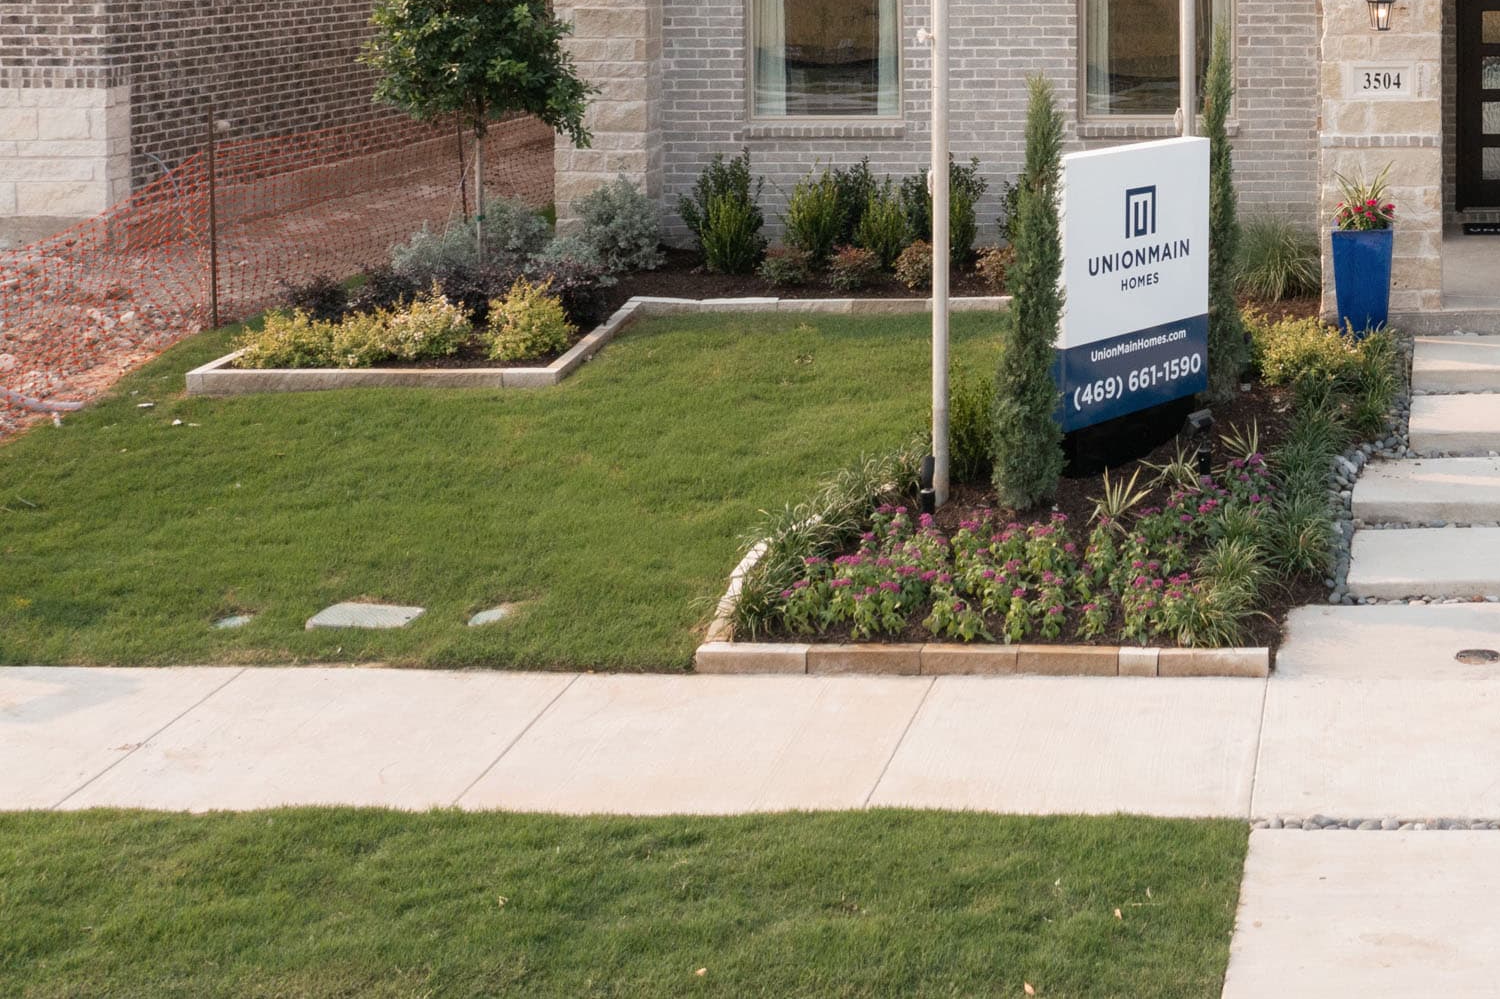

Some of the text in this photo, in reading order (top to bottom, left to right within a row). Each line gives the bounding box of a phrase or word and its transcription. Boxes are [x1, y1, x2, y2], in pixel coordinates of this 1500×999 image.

[1363, 72, 1401, 89] 3504
[1088, 238, 1191, 276] UNIONMAIN
[1120, 272, 1160, 292] HOMES
[1091, 329, 1186, 362] UnionMainHomes.com
[1074, 353, 1201, 411] (469) 661-1590
